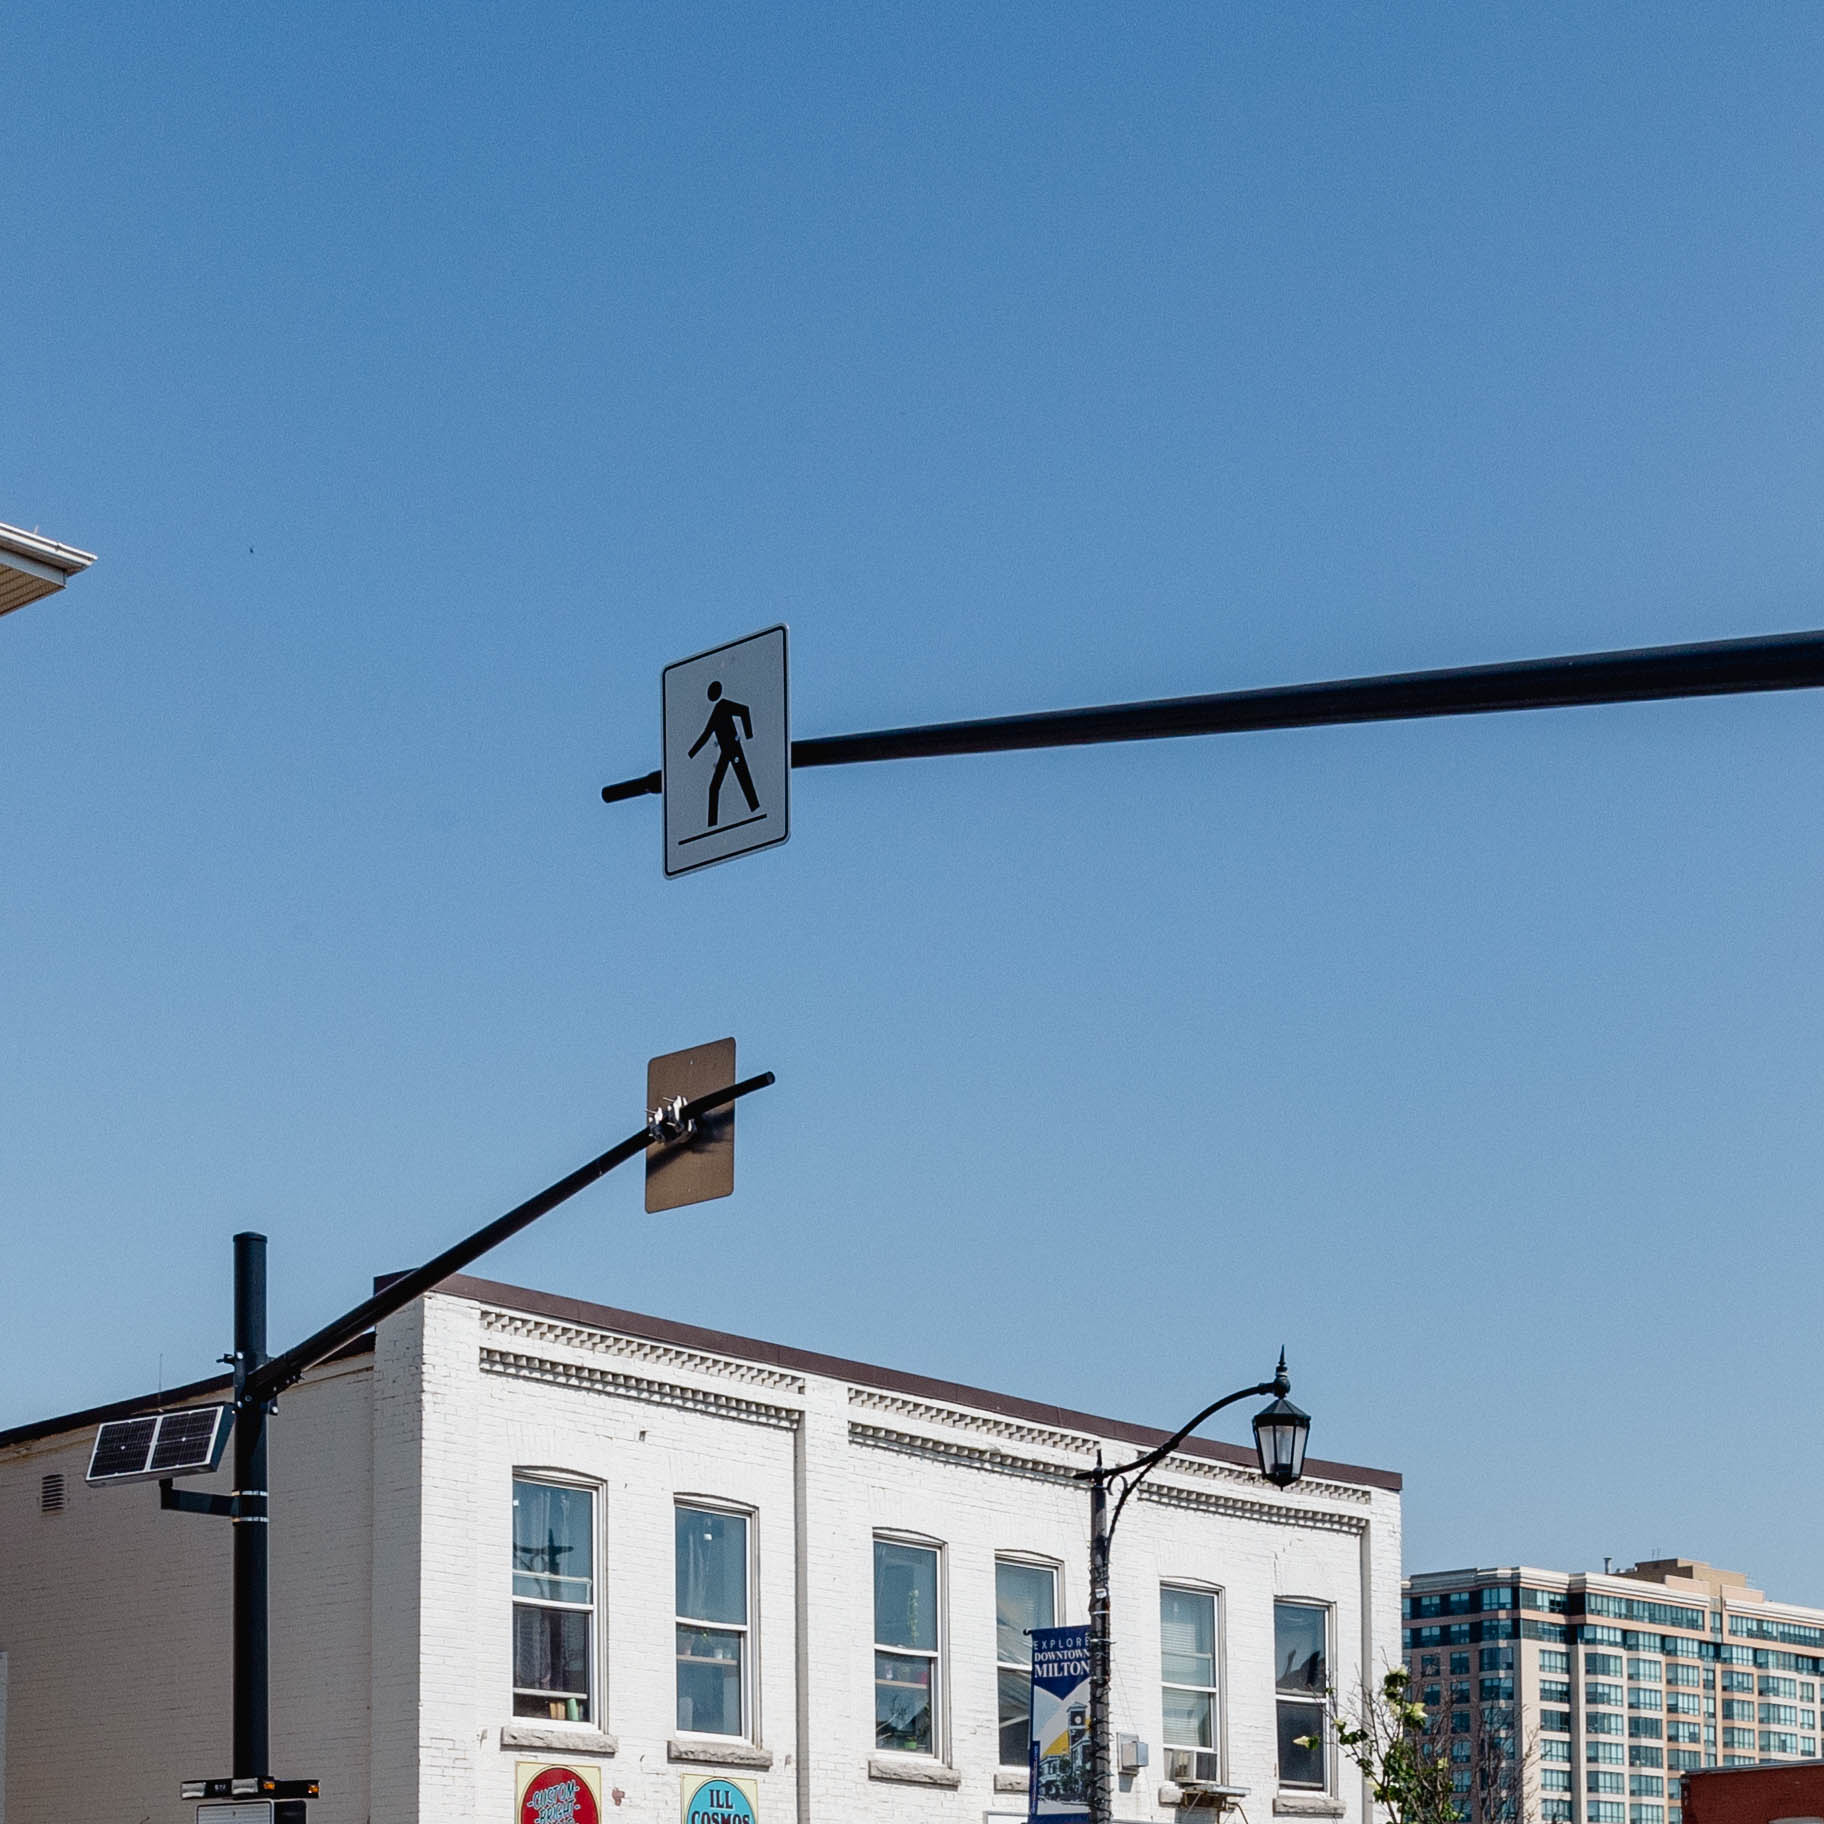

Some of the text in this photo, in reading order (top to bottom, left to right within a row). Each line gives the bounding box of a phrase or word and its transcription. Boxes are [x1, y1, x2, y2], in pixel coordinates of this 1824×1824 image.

[1033, 1635, 1090, 1651] EXPLORE
[1034, 1648, 1090, 1662] DOWNTOWN
[1034, 1660, 1090, 1678] MILTON
[709, 1789, 733, 1809] ILL
